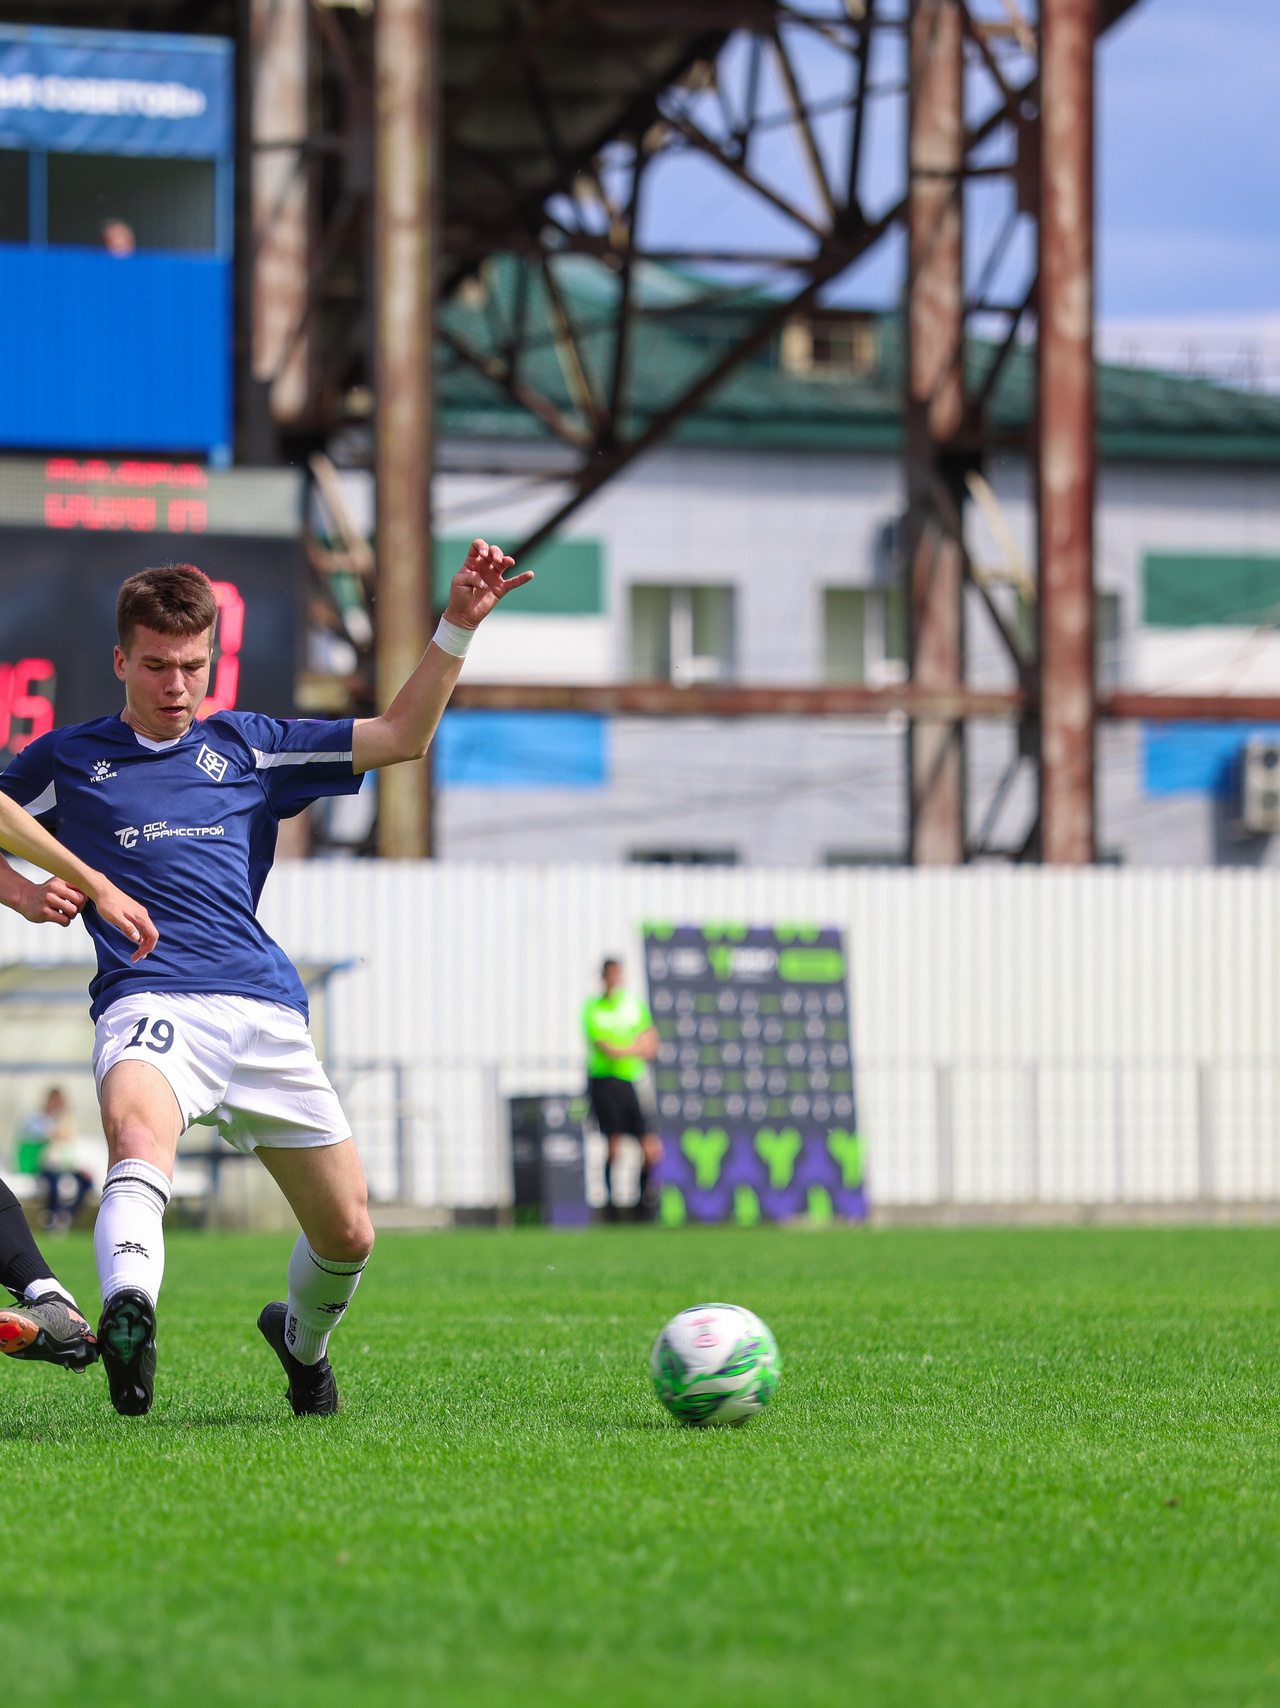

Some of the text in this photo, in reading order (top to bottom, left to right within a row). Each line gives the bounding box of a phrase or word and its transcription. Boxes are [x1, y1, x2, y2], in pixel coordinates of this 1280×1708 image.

[90, 771, 118, 783] KELME
[143, 821, 167, 834] ДСК
[144, 825, 224, 842] ТРАНССТРОЙ
[124, 1017, 174, 1054] 19
